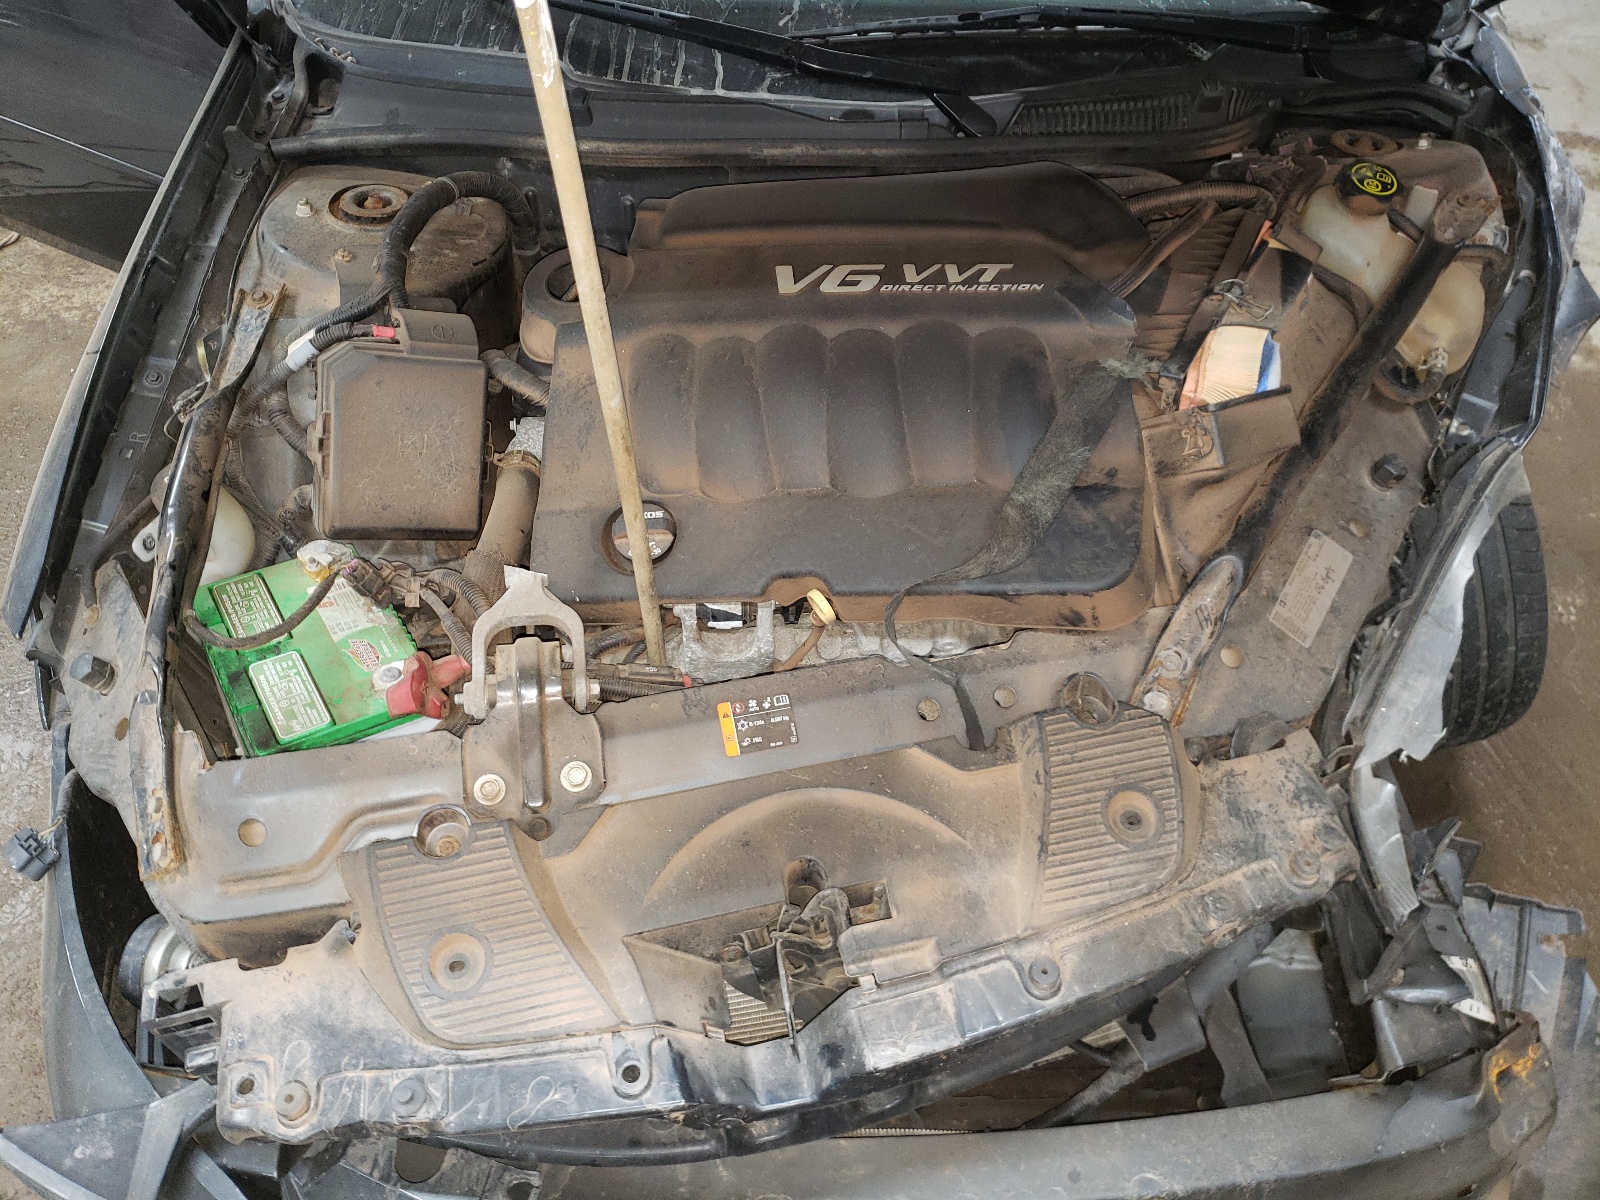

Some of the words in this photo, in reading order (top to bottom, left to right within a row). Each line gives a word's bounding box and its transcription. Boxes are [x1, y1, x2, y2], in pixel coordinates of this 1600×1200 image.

[775, 264, 886, 293] V6
[903, 263, 1015, 283] VVT
[880, 284, 947, 293] DIRECT
[949, 283, 1046, 292] INJECTION
[350, 640, 371, 669] INTERSTATE
